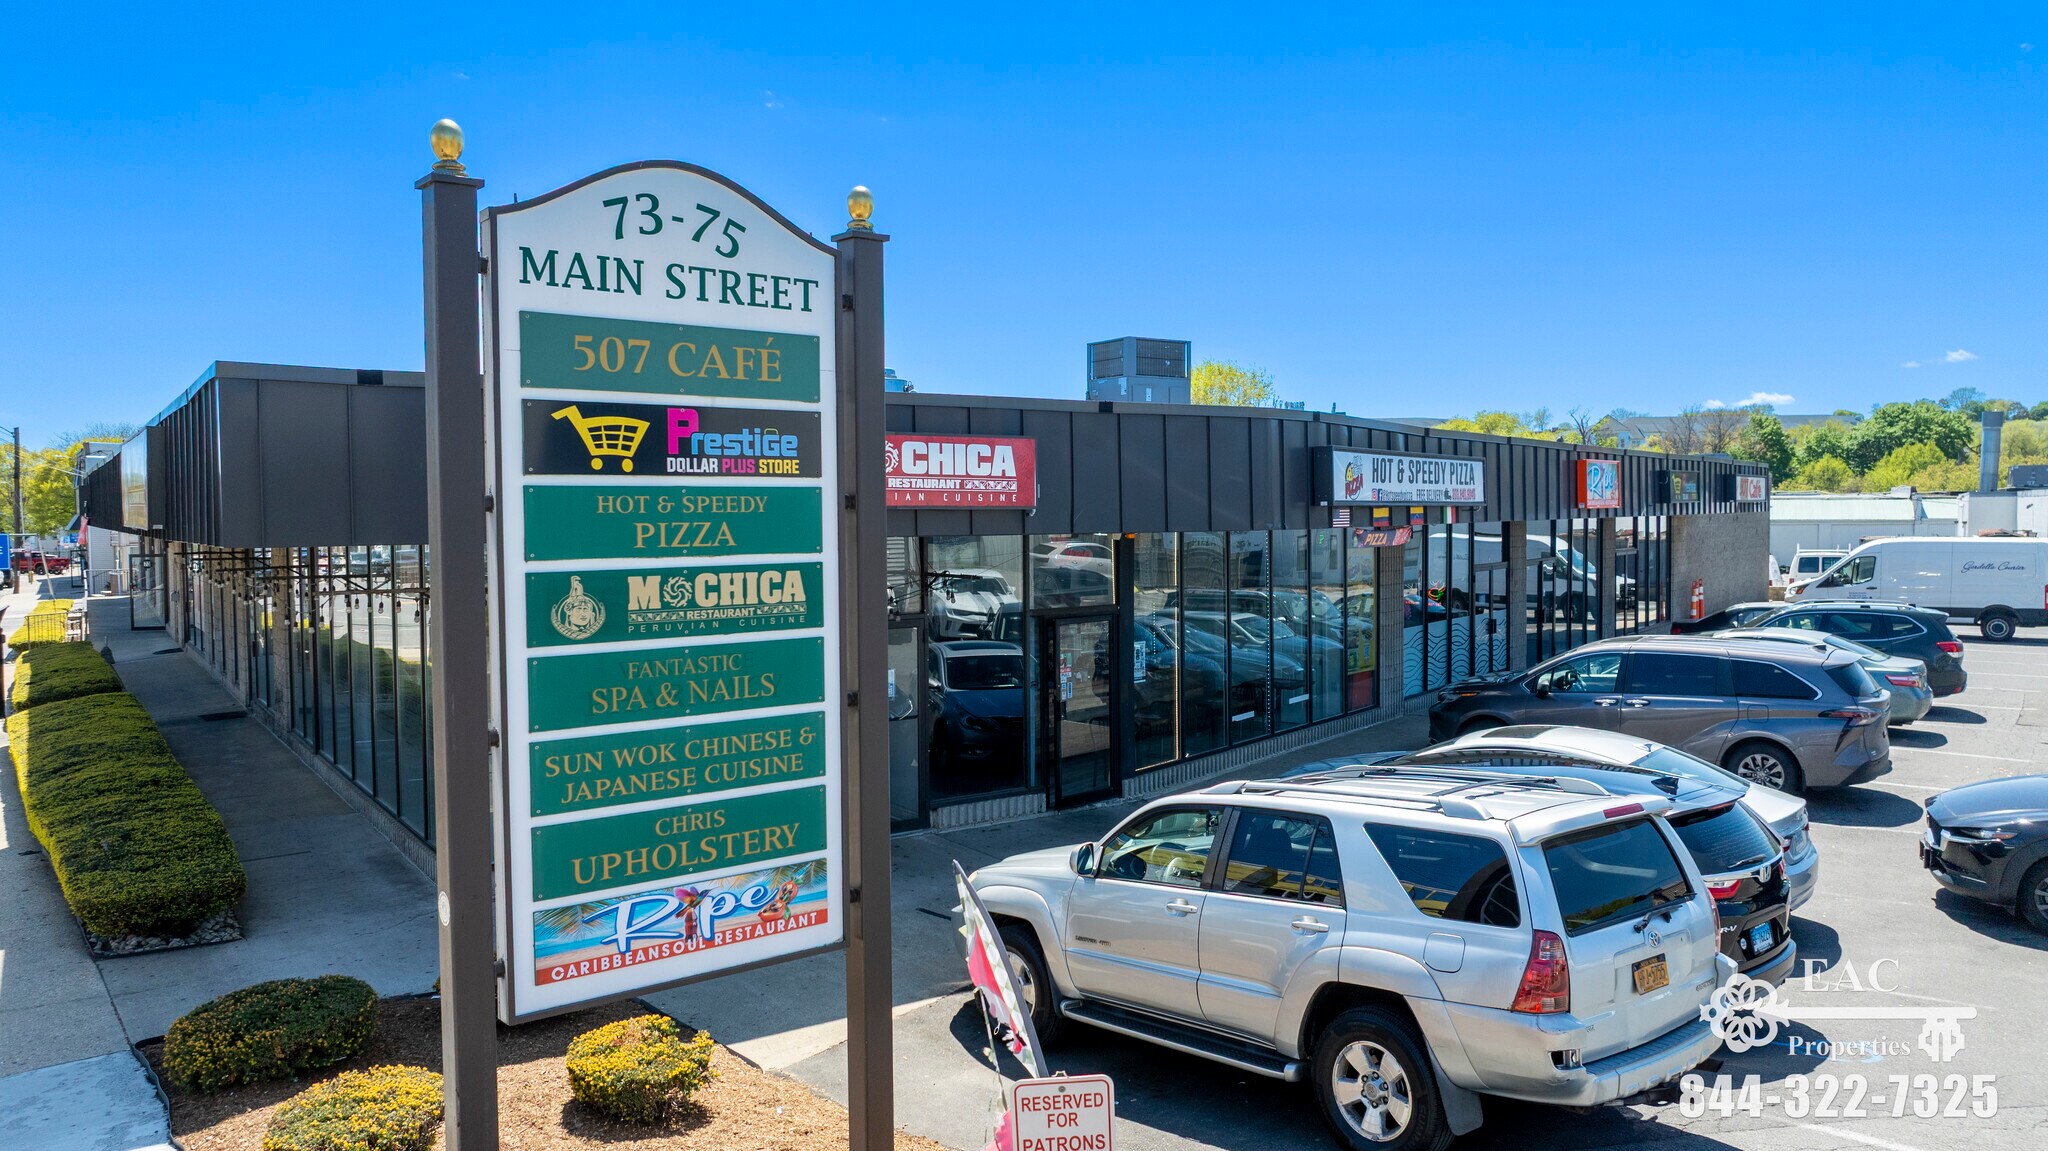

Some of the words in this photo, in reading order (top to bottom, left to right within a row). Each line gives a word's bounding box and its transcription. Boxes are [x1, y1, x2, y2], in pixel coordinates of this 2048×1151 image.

[602, 193, 746, 258] 73-75
[519, 246, 644, 296] MAIN
[666, 263, 818, 312] STREET
[573, 334, 651, 374] 507
[668, 337, 782, 382] CAFÉ
[666, 457, 718, 473] DOLLAR
[722, 458, 756, 474] PLUS
[758, 459, 800, 474] STORE
[886, 440, 1017, 477] CHICA
[1372, 458, 1393, 484] HOT
[1398, 459, 1404, 484] &
[1408, 460, 1446, 485] SPEEDY
[1450, 462, 1476, 486] PIZZA
[888, 478, 962, 489] RESTAURANT
[1416, 488, 1426, 500] FREE
[596, 495, 650, 514] HOT
[657, 495, 675, 513] &
[682, 495, 768, 514] SPEEDY
[944, 493, 1017, 502] CUISINE
[634, 521, 737, 548] PIZZA
[1364, 533, 1388, 546] PIZZA
[628, 620, 719, 633] PERUVIAN
[739, 615, 806, 626] CUISINE
[686, 607, 755, 620] RESTAURANT
[628, 653, 742, 680] FANTASTIC
[591, 685, 648, 714] SPA
[656, 682, 679, 708] &
[688, 672, 775, 704] NAILS
[545, 751, 603, 778] SUN
[612, 742, 677, 769] WOK
[684, 729, 792, 759] CHINESE
[799, 727, 816, 745] &
[561, 767, 697, 804] JAPANESE
[704, 752, 804, 784] CUISINE
[655, 809, 726, 836] CHRIS
[572, 822, 800, 886] UPHOLSTERY
[1719, 925, 1738, 934] R-V
[551, 936, 706, 981] CARIBBEANSOUL
[714, 912, 818, 946] RESTAURANT
[1021, 1092, 1104, 1112] RESERVED
[1047, 1112, 1078, 1128] FOR
[1023, 1134, 1106, 1151] PATRONS
